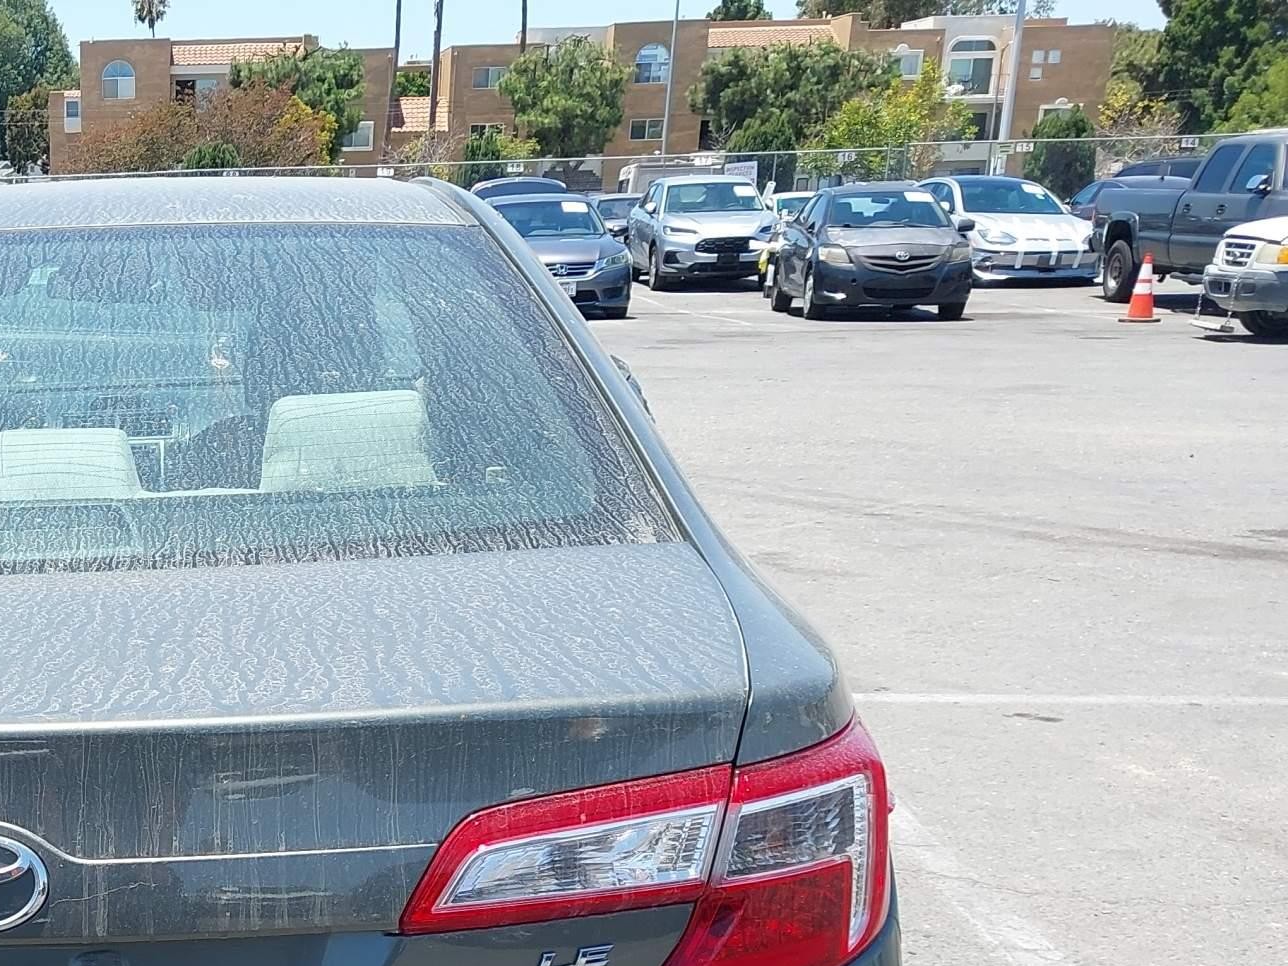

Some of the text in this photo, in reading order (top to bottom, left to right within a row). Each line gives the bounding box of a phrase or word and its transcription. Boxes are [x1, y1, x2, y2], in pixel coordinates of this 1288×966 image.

[1184, 138, 1196, 146] 14
[1019, 143, 1031, 151] 15
[842, 152, 853, 161] 16
